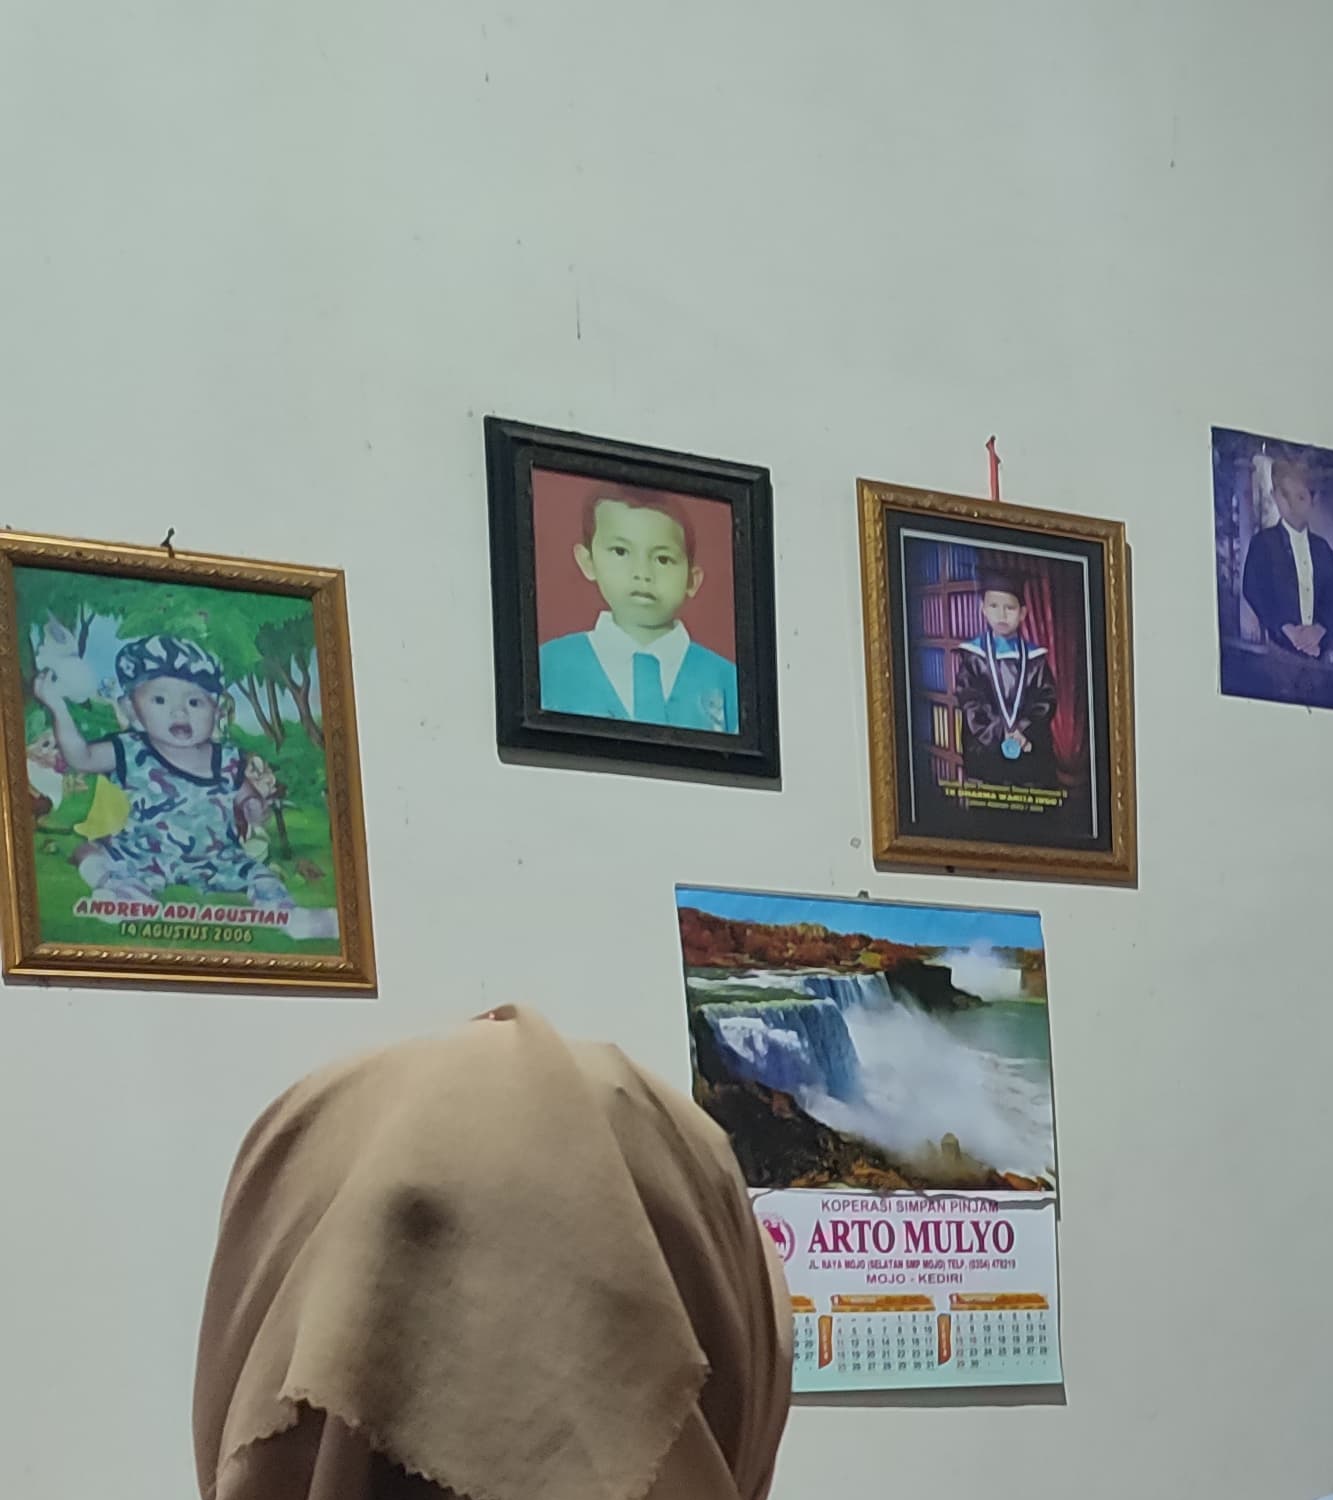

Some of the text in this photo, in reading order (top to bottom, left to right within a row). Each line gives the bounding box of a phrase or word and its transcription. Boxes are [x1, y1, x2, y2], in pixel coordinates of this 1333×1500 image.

[76, 900, 289, 925] ANDREW ADI AGUSTIAN
[142, 924, 208, 940] AGUSTUS
[214, 927, 252, 943] 2006
[821, 1199, 999, 1213] KOPERASI SIMPAN PINJAM
[808, 1219, 1015, 1253] ARTO MULYO
[848, 1259, 865, 1270] MOJO
[866, 1273, 905, 1284] MOJO
[918, 1273, 963, 1284] KEDIRI
